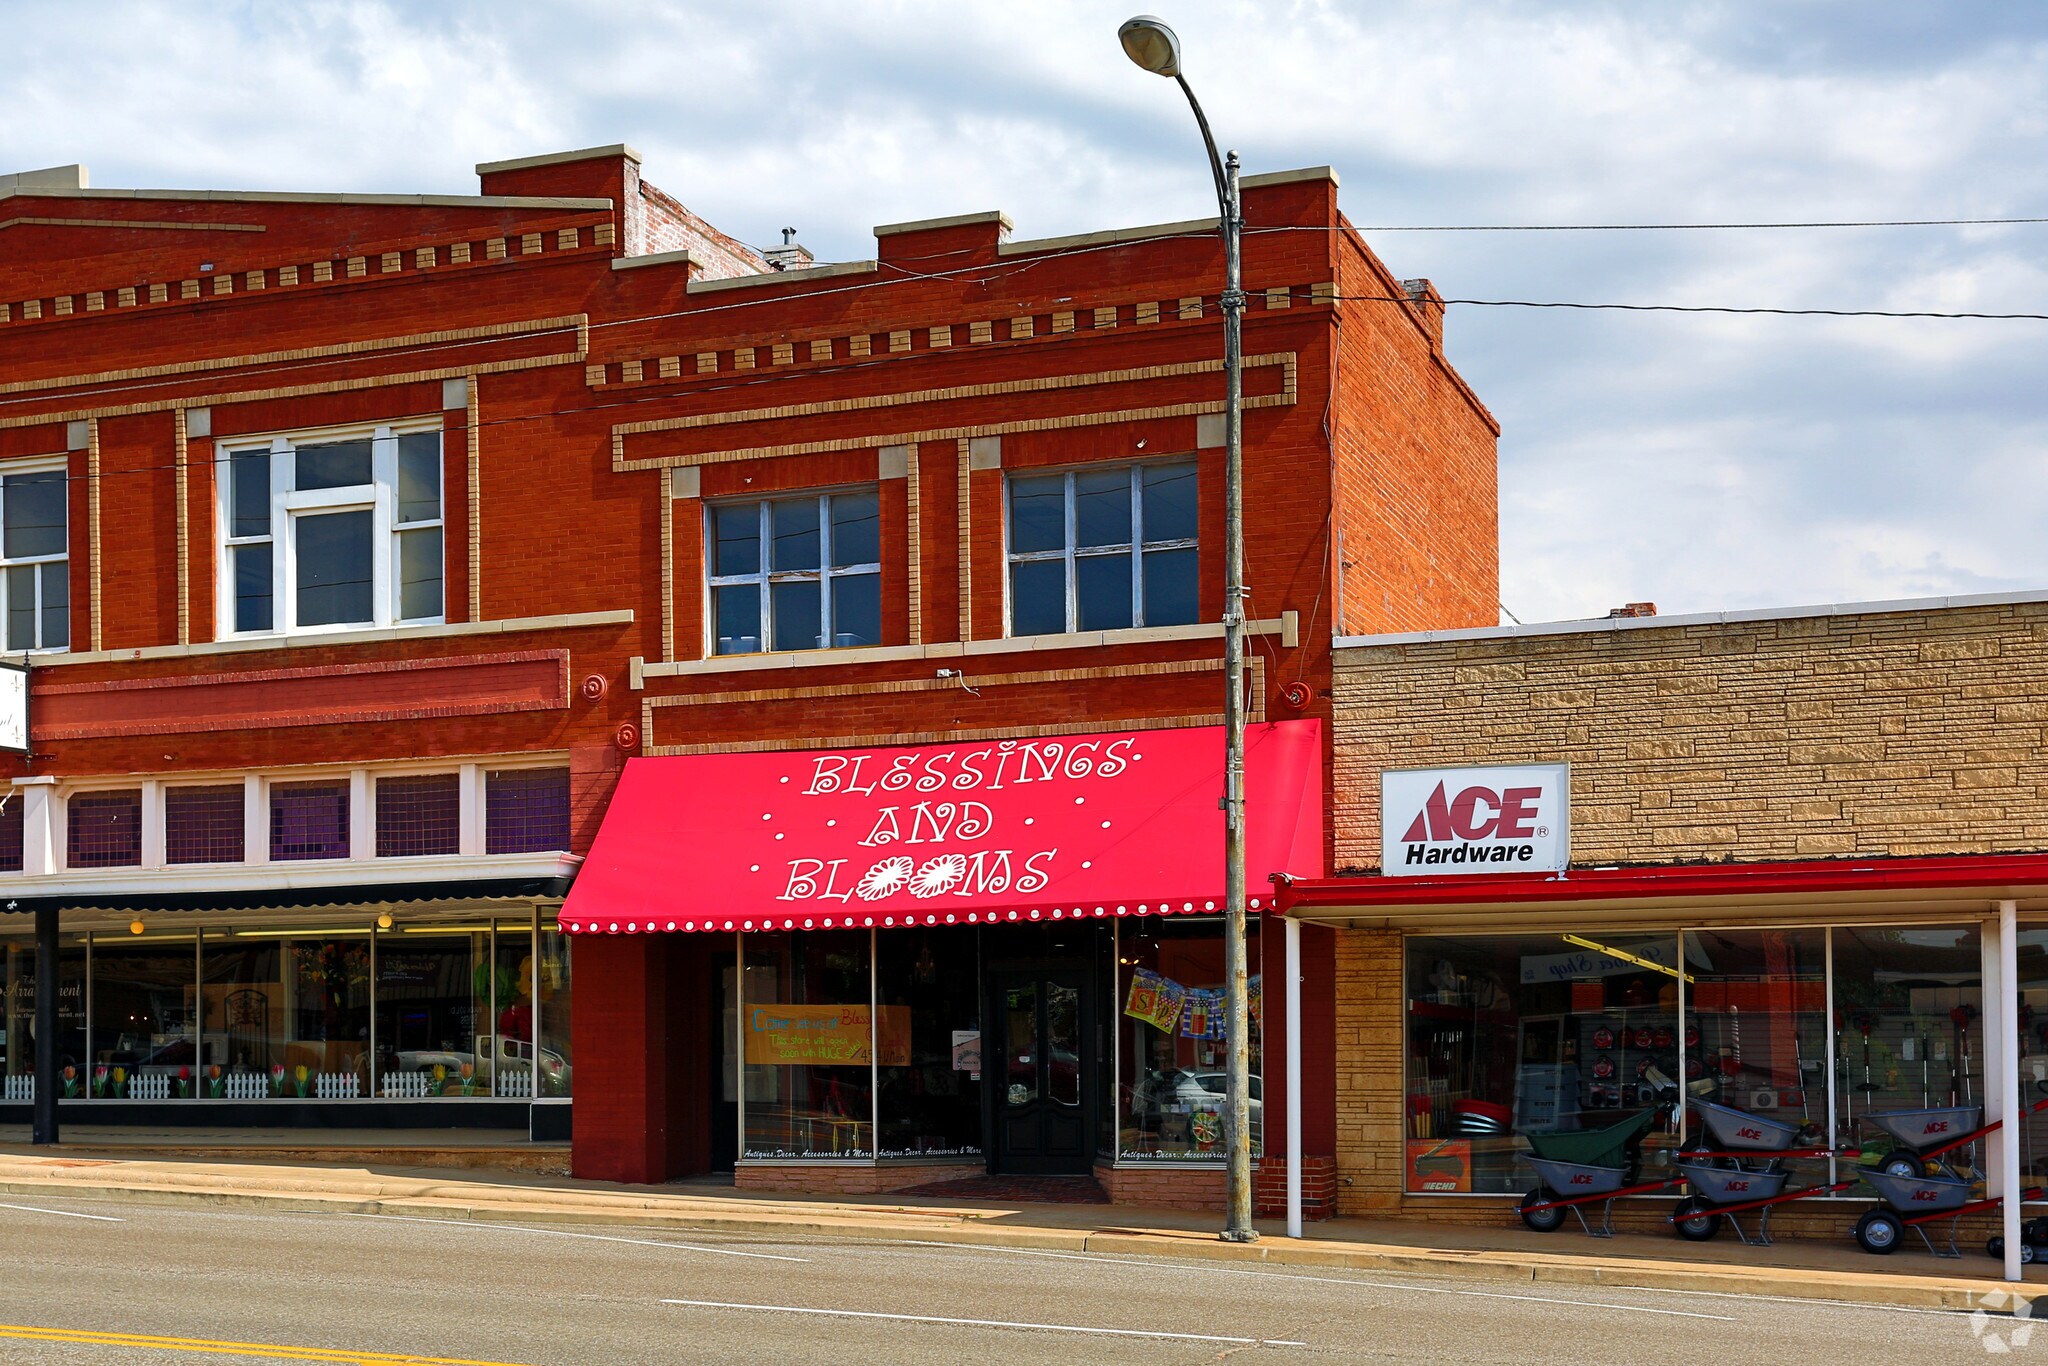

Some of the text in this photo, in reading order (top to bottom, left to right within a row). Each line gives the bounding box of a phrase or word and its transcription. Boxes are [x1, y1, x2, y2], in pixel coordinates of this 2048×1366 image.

[801, 738, 1136, 798] BLESSINGS
[1400, 779, 1542, 842] ACE
[858, 799, 994, 848] AND
[1405, 843, 1533, 865] Hardware
[775, 847, 1058, 904] BLOOMS
[753, 1009, 790, 1032] Come
[768, 1033, 848, 1047] This store will open
[780, 1050, 800, 1059] soon
[803, 1048, 816, 1057] with
[818, 1046, 843, 1059] HUGE
[1736, 1127, 1763, 1141] ACE
[1923, 1121, 1948, 1135] ACE
[801, 1148, 842, 1158] Accessories
[844, 1148, 850, 1157] &
[853, 1148, 872, 1158] More
[925, 1146, 958, 1156] Accessories
[966, 1145, 982, 1154] More
[1183, 1149, 1227, 1159] Accessories
[1430, 1182, 1456, 1190] ECHO
[1570, 1174, 1593, 1185] ACE
[1724, 1181, 1750, 1192] ACE
[1911, 1190, 1938, 1201] ACE
